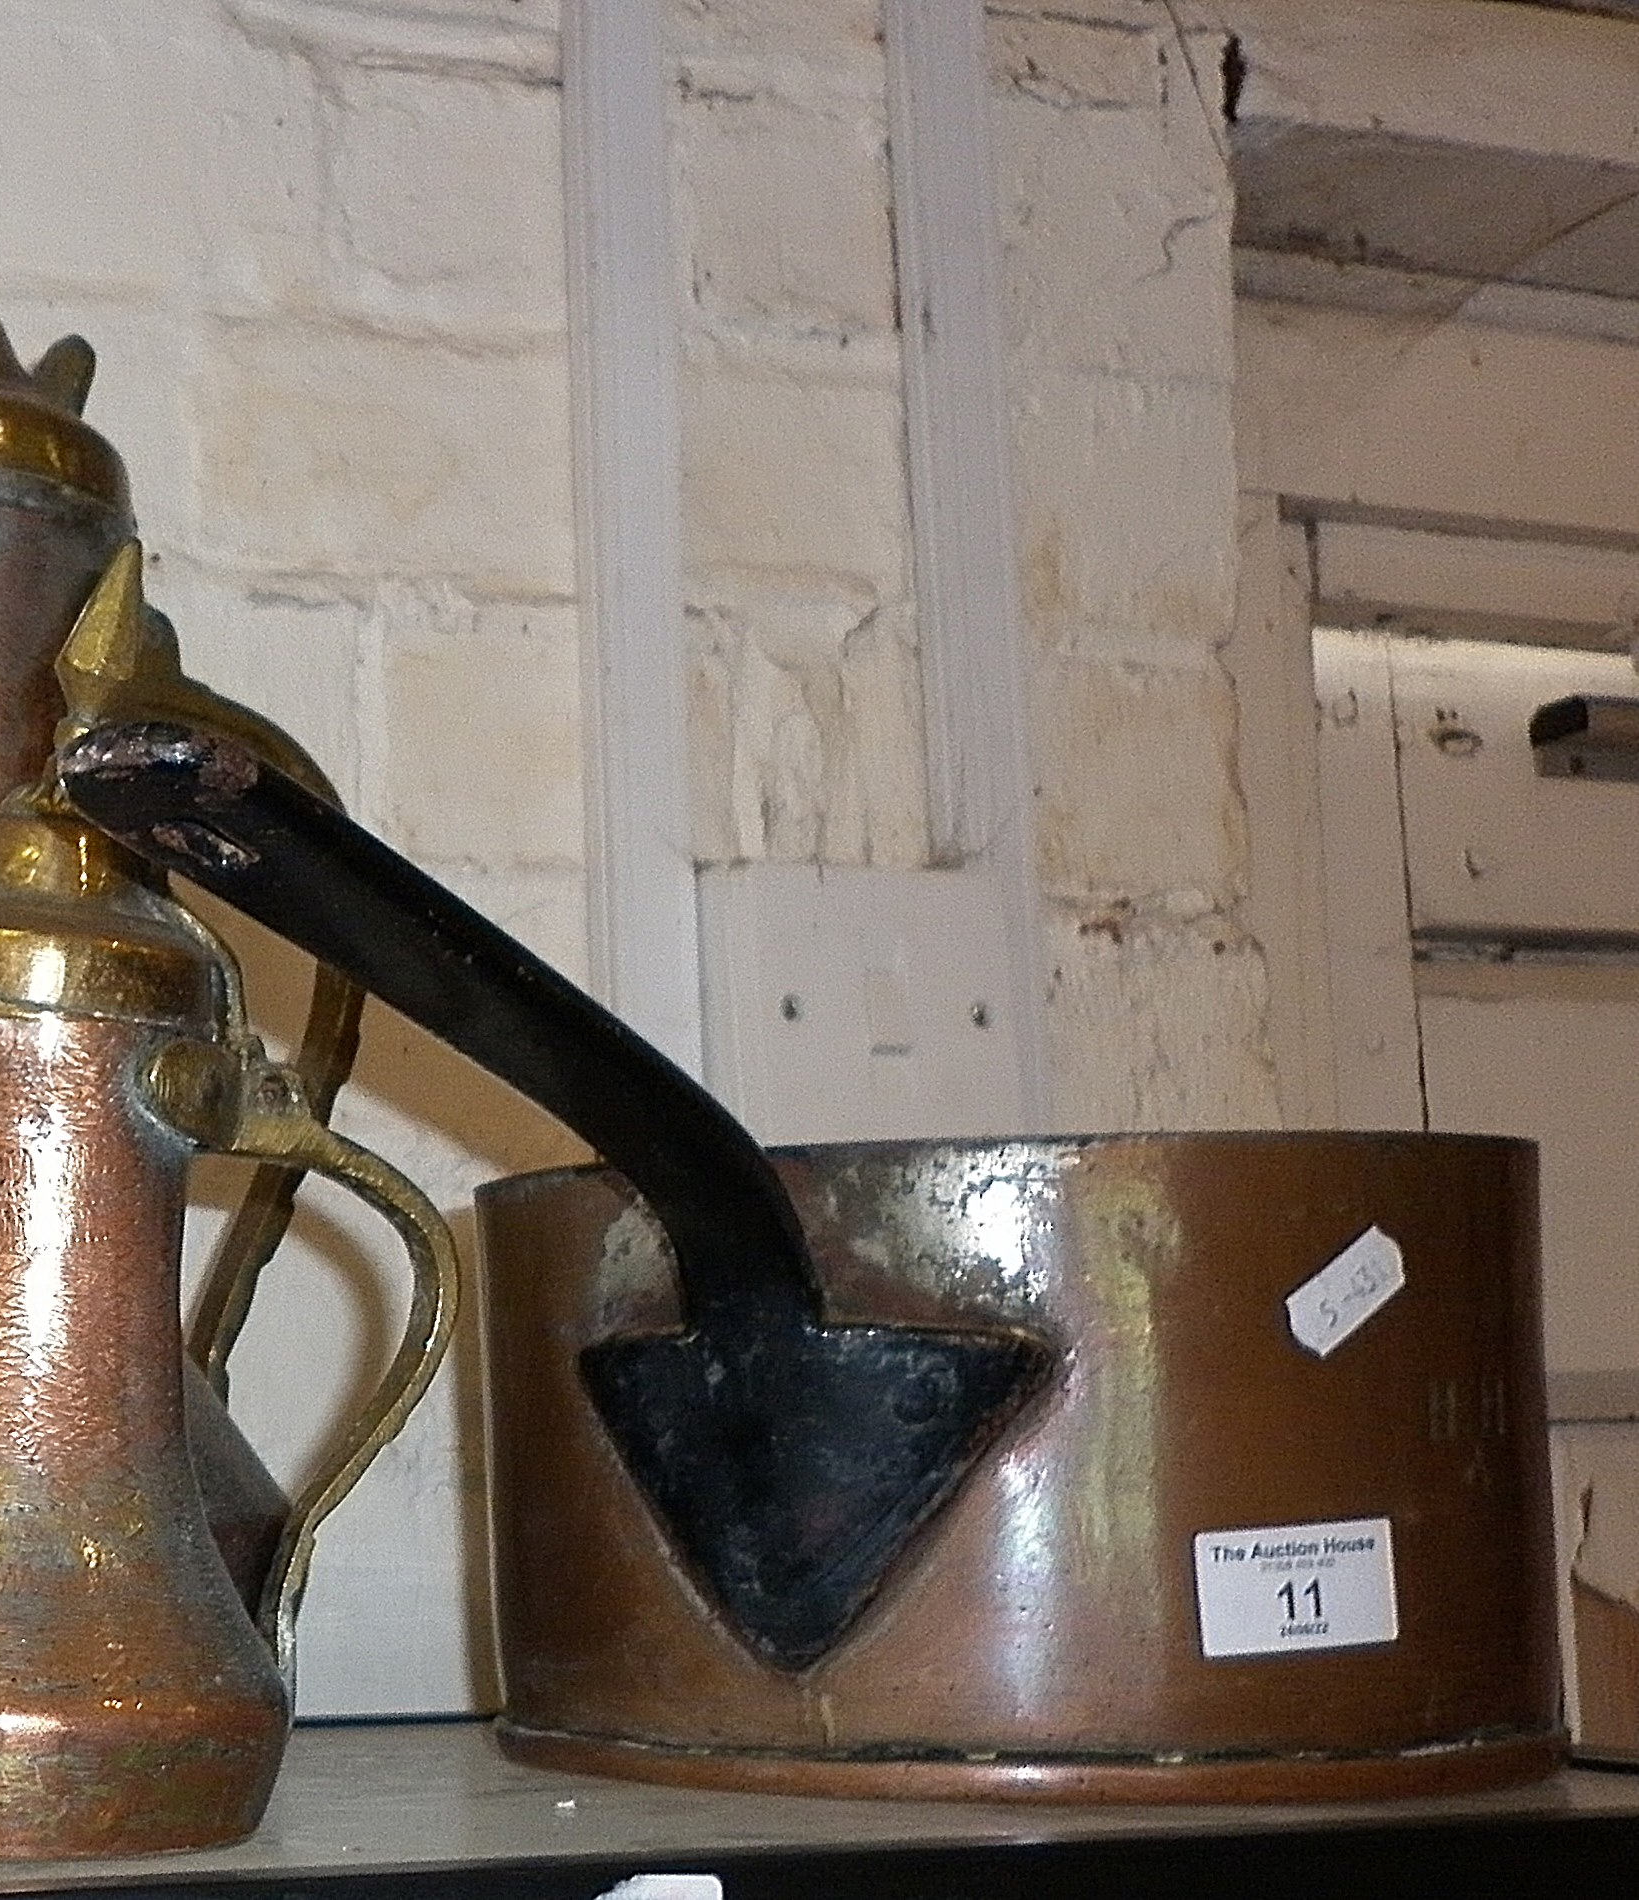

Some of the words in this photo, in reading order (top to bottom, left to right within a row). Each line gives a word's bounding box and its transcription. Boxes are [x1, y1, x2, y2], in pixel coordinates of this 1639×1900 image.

[1210, 1545, 1246, 1562] The
[1251, 1541, 1319, 1559] Auction
[1323, 1536, 1375, 1554] House
[1277, 1578, 1322, 1620] 11
